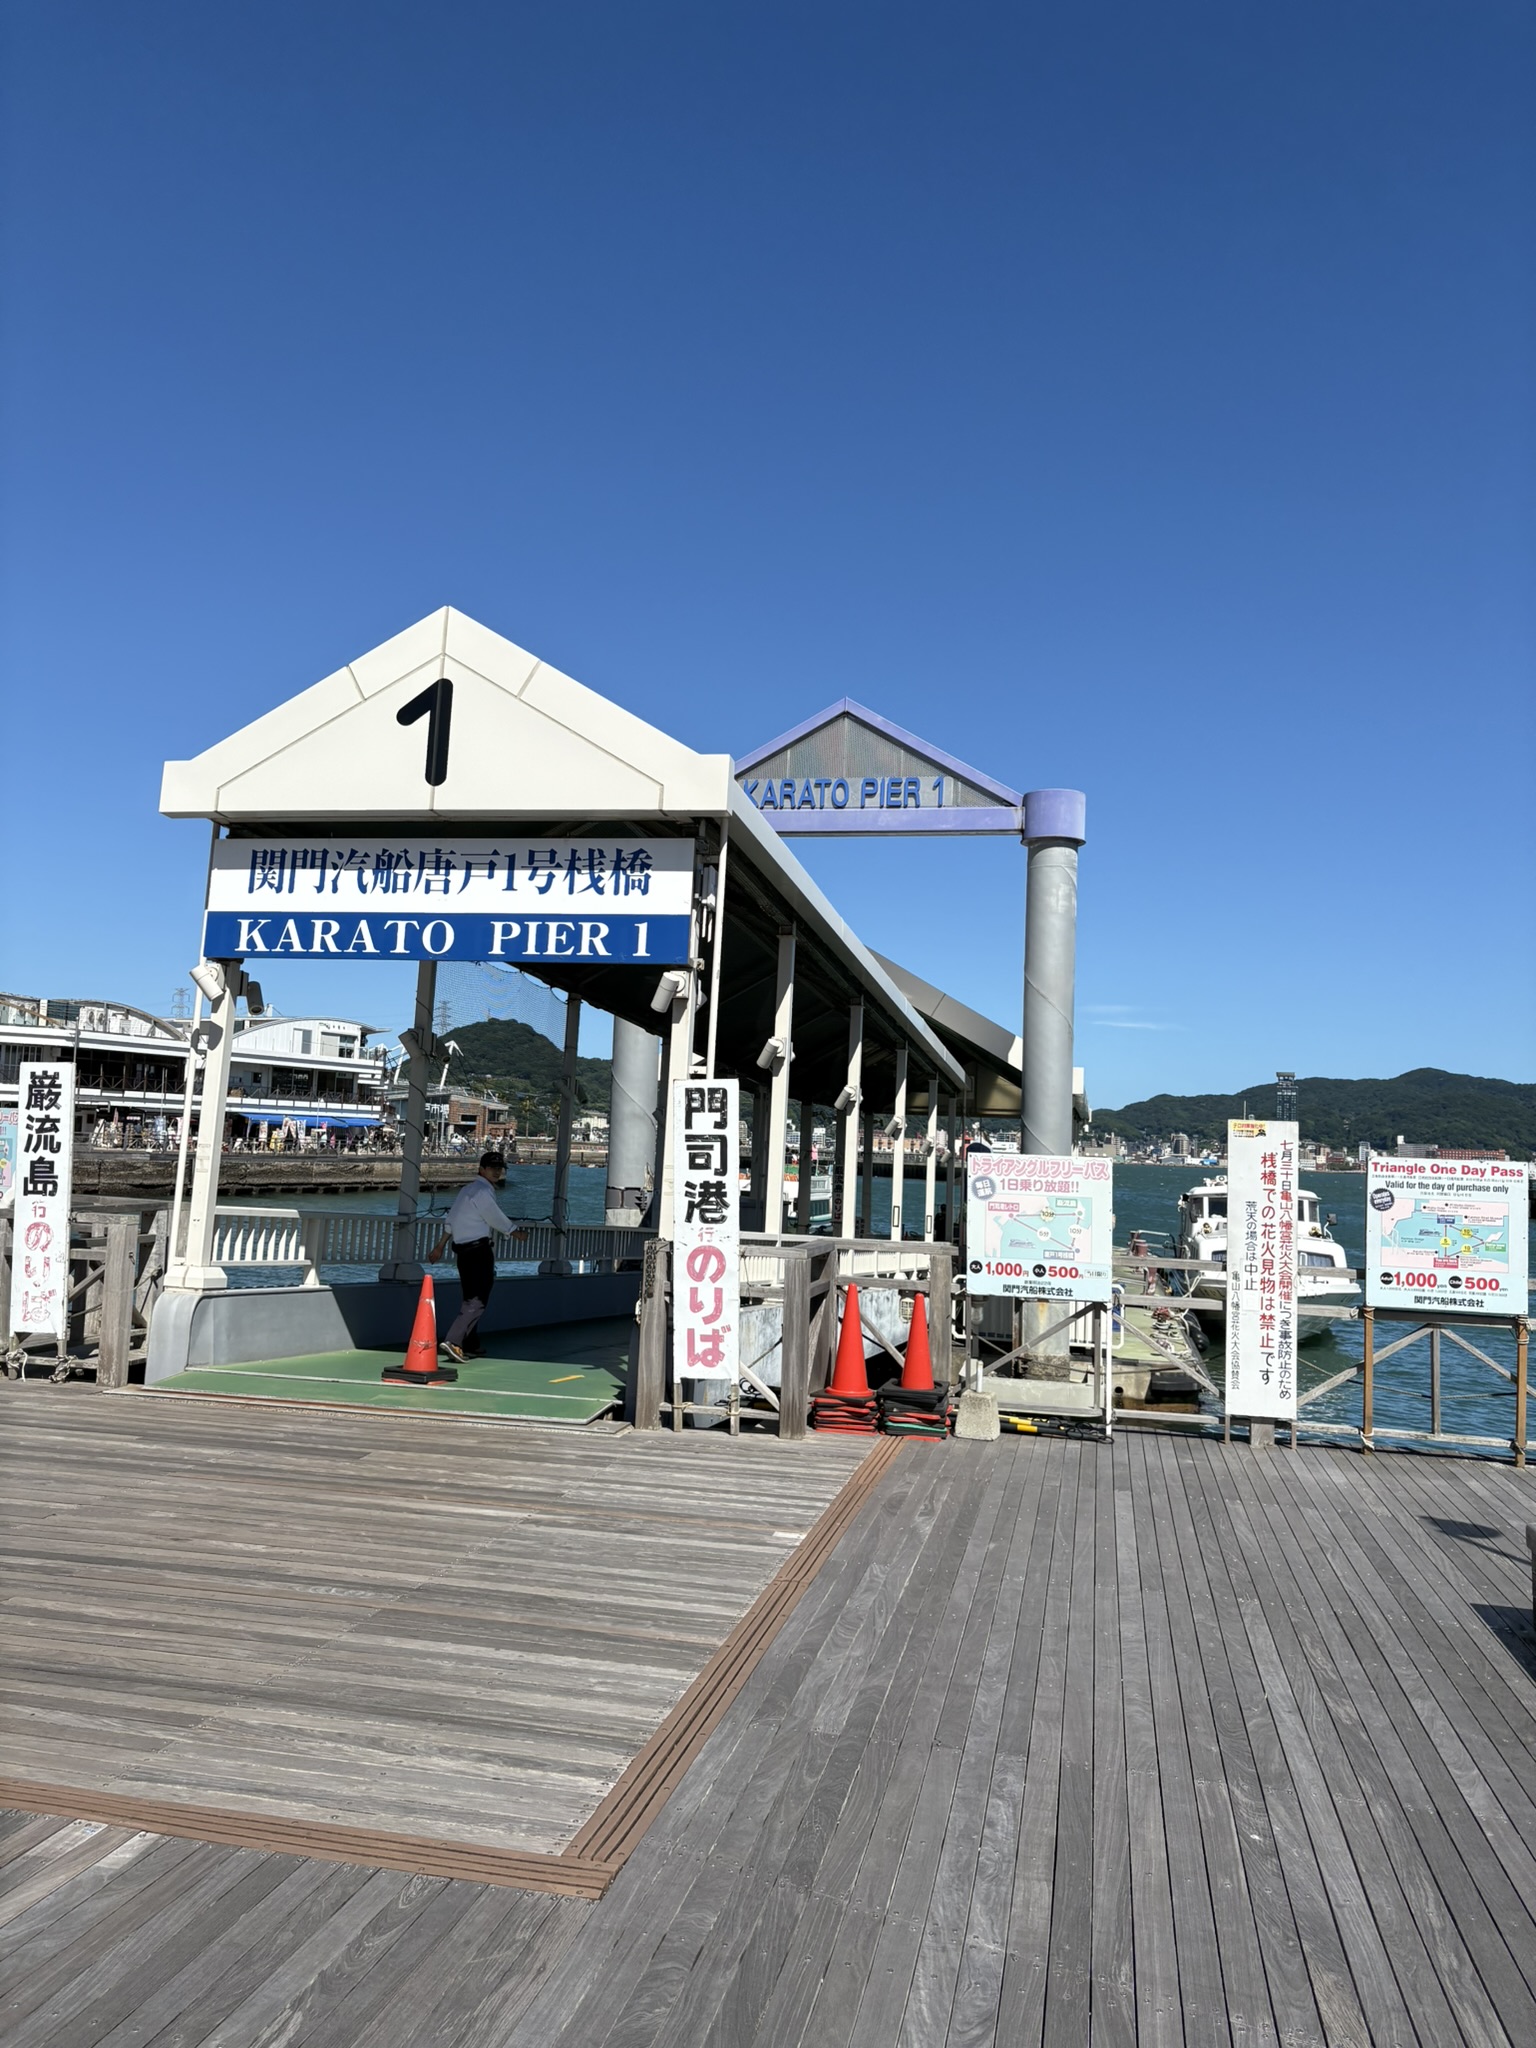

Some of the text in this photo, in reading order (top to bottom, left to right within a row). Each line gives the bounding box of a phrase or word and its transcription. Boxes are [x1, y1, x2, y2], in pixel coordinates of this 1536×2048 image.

[396, 678, 454, 787] 1
[743, 775, 945, 810] KARATO PIER 1
[247, 847, 653, 897] 関門汽船唐戸1号桟橋
[234, 918, 652, 957] KARATO PIER 1
[970, 1156, 1110, 1181] トライアングルフリーパス
[1371, 1162, 1524, 1178] Triangle One Day Pass
[1000, 1178, 1080, 1194] 1日乗り放題!!
[1385, 1181, 1405, 1190] Valid
[1406, 1181, 1417, 1190] for
[1417, 1181, 1430, 1190] the
[1431, 1182, 1446, 1193] day
[1447, 1183, 1455, 1191] of
[1456, 1183, 1491, 1194] purchase
[1492, 1185, 1509, 1195] only
[684, 1086, 731, 1369] 門司港行のりば
[1244, 1200, 1258, 1291] 荒天の場合は中止
[985, 1261, 1029, 1278] 1,000円
[1259, 1152, 1278, 1386] 桟橋での花火見物は禁止です
[1278, 1139, 1294, 1400] 七月三十日亀山八幡宮花火大会開催につき事故防止のため
[1394, 1271, 1438, 1288] 1,000
[1002, 1283, 1074, 1297] 関門汽船株式会社
[1464, 1276, 1500, 1292] 500
[1414, 1295, 1485, 1308] 関門汽船株式会社
